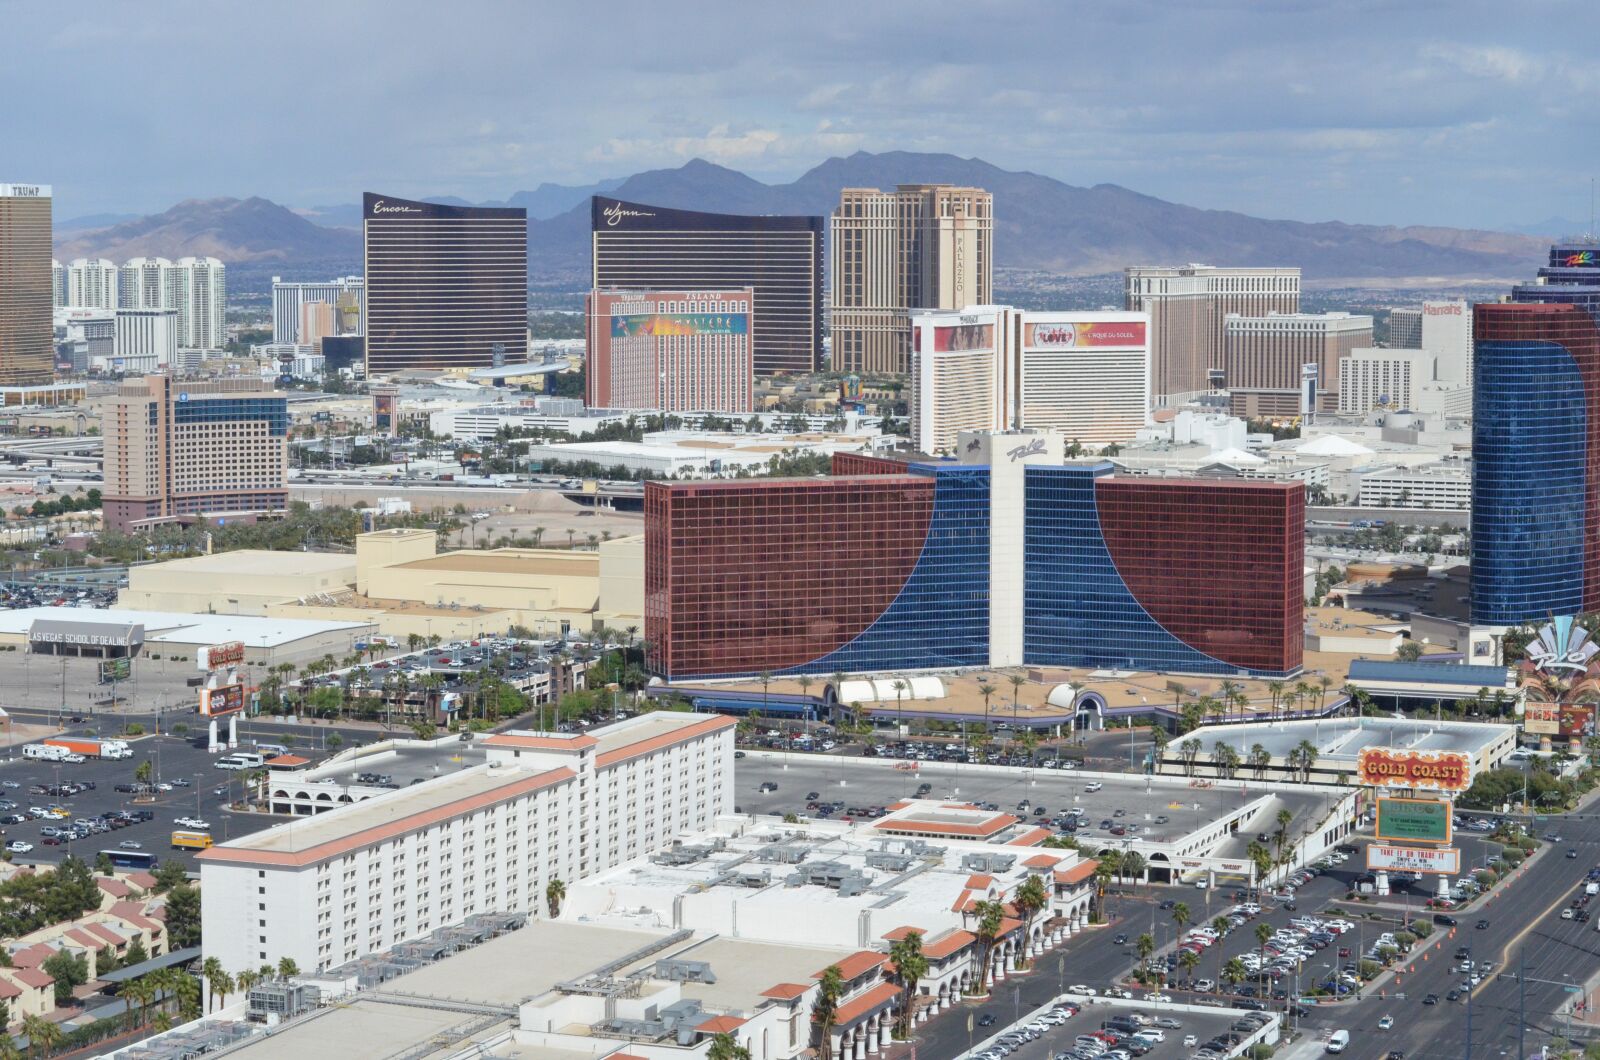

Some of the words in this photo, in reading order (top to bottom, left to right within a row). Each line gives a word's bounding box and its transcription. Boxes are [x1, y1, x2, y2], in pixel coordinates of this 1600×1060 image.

[12, 186, 40, 196] TRUMP
[373, 200, 422, 213] Encore
[603, 202, 656, 226] Wynn
[42, 632, 63, 643] VEGAS
[65, 634, 91, 644] SCHOOL
[91, 636, 100, 645] OF
[1368, 762, 1407, 775] GOLD
[1411, 764, 1460, 778] COAST
[1380, 848, 1393, 857] TAKE
